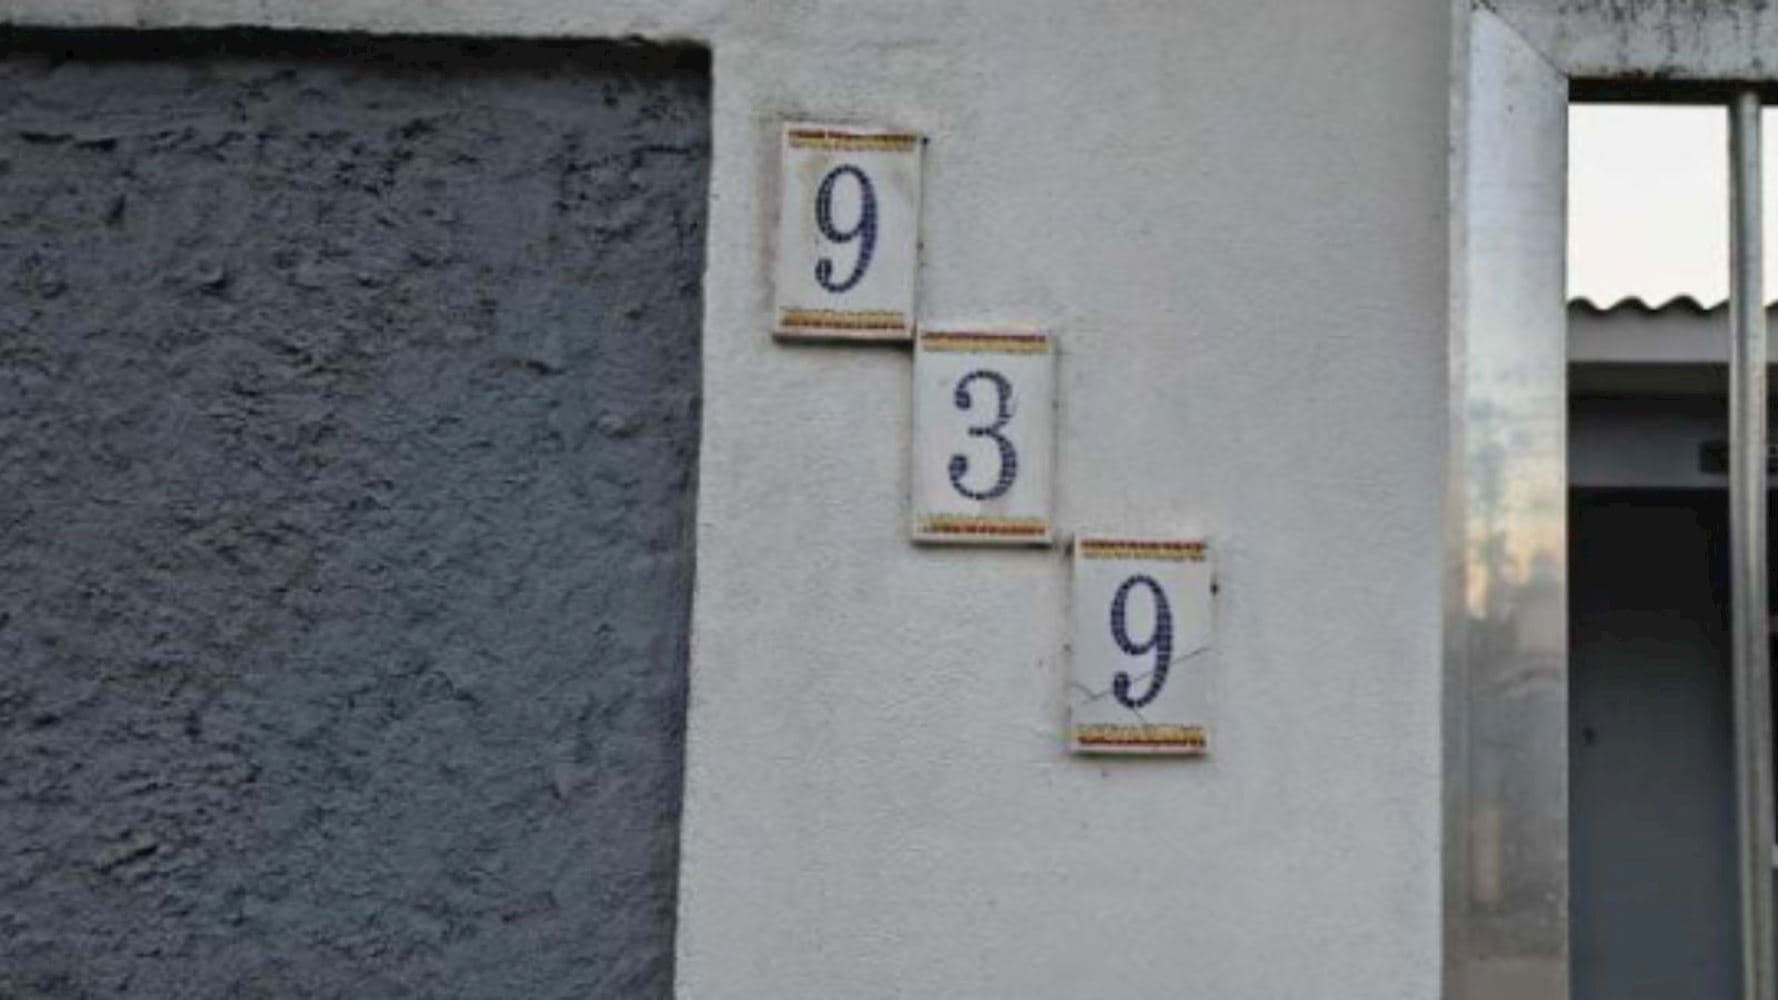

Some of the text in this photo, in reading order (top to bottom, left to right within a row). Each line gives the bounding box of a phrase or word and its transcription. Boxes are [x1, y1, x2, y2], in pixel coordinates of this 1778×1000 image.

[815, 164, 878, 293] 9
[948, 369, 1018, 501] 3
[1110, 574, 1173, 709] 9
